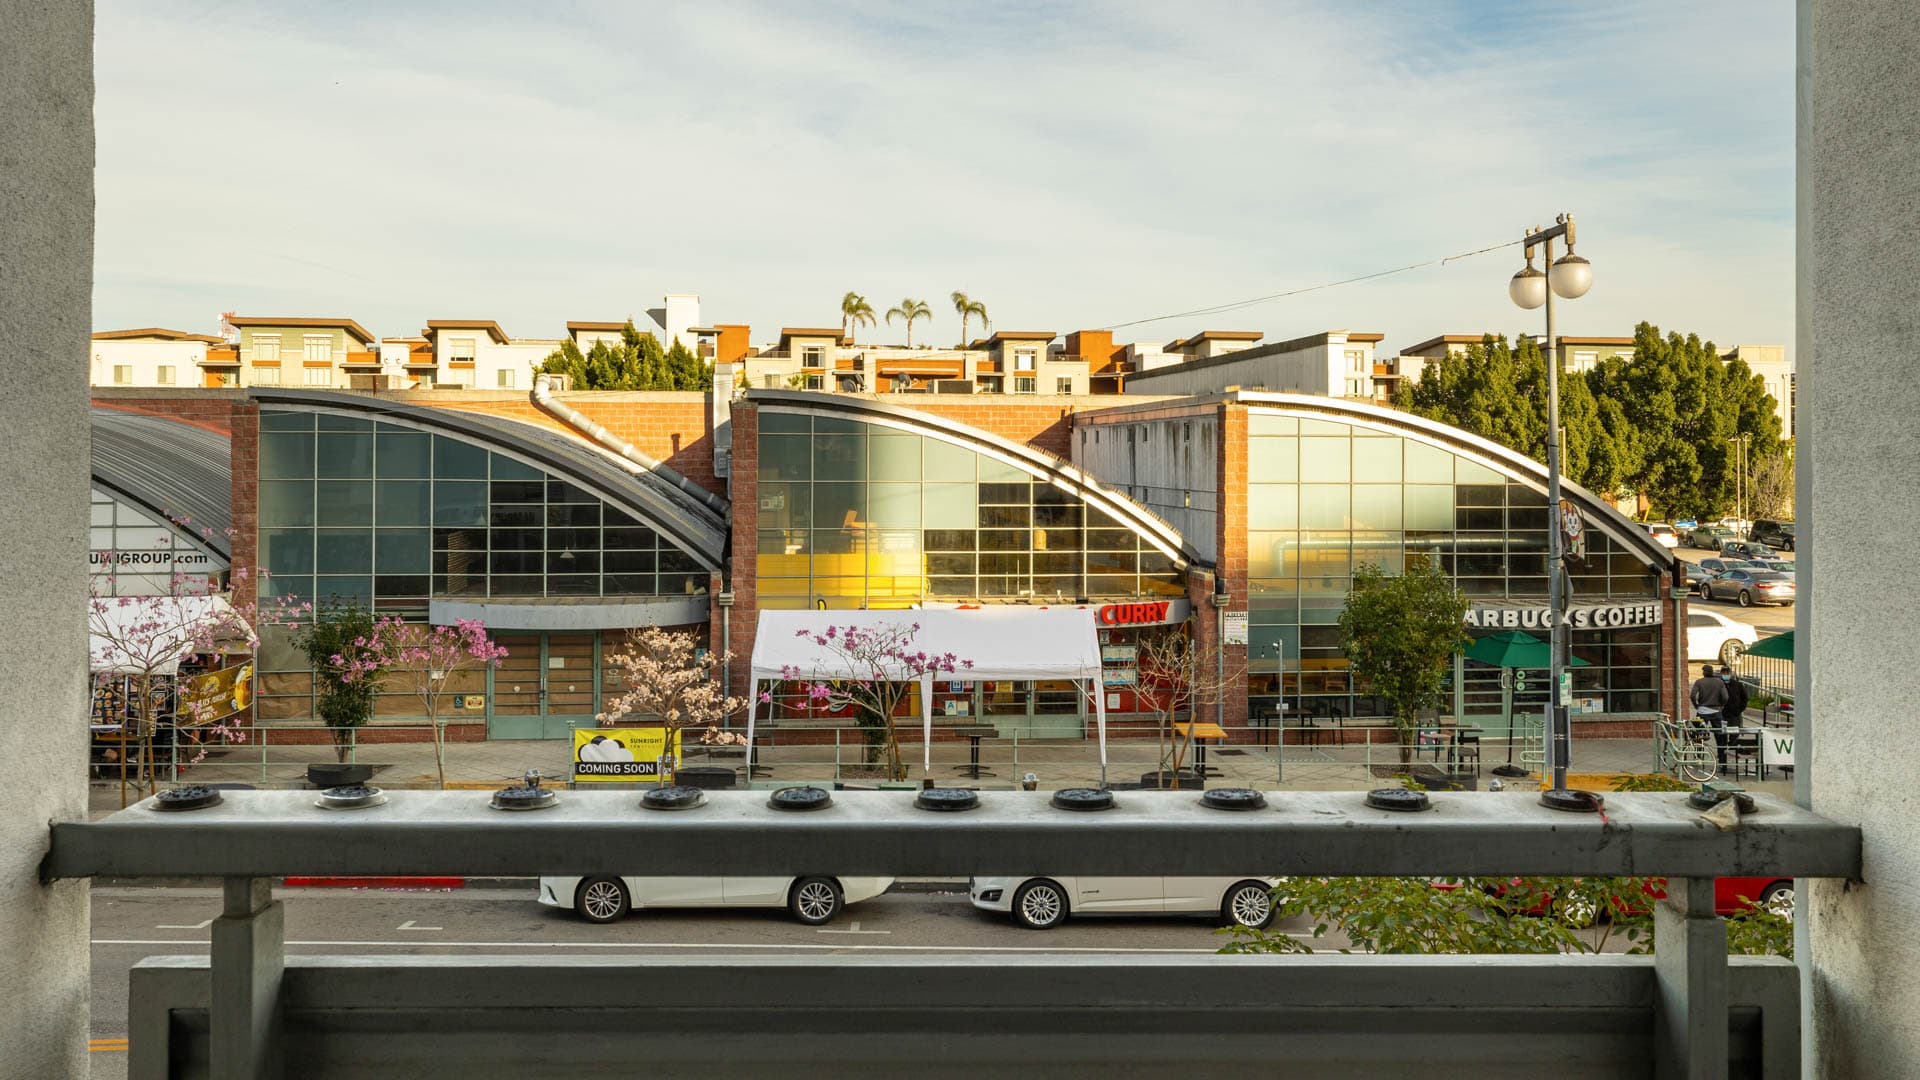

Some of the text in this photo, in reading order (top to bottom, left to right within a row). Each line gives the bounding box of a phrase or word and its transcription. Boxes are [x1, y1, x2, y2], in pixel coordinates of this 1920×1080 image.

[1101, 601, 1170, 625] CURRY
[1462, 606, 1661, 628] ARBUCS COFFEE
[579, 764, 654, 774] COMING SOON
